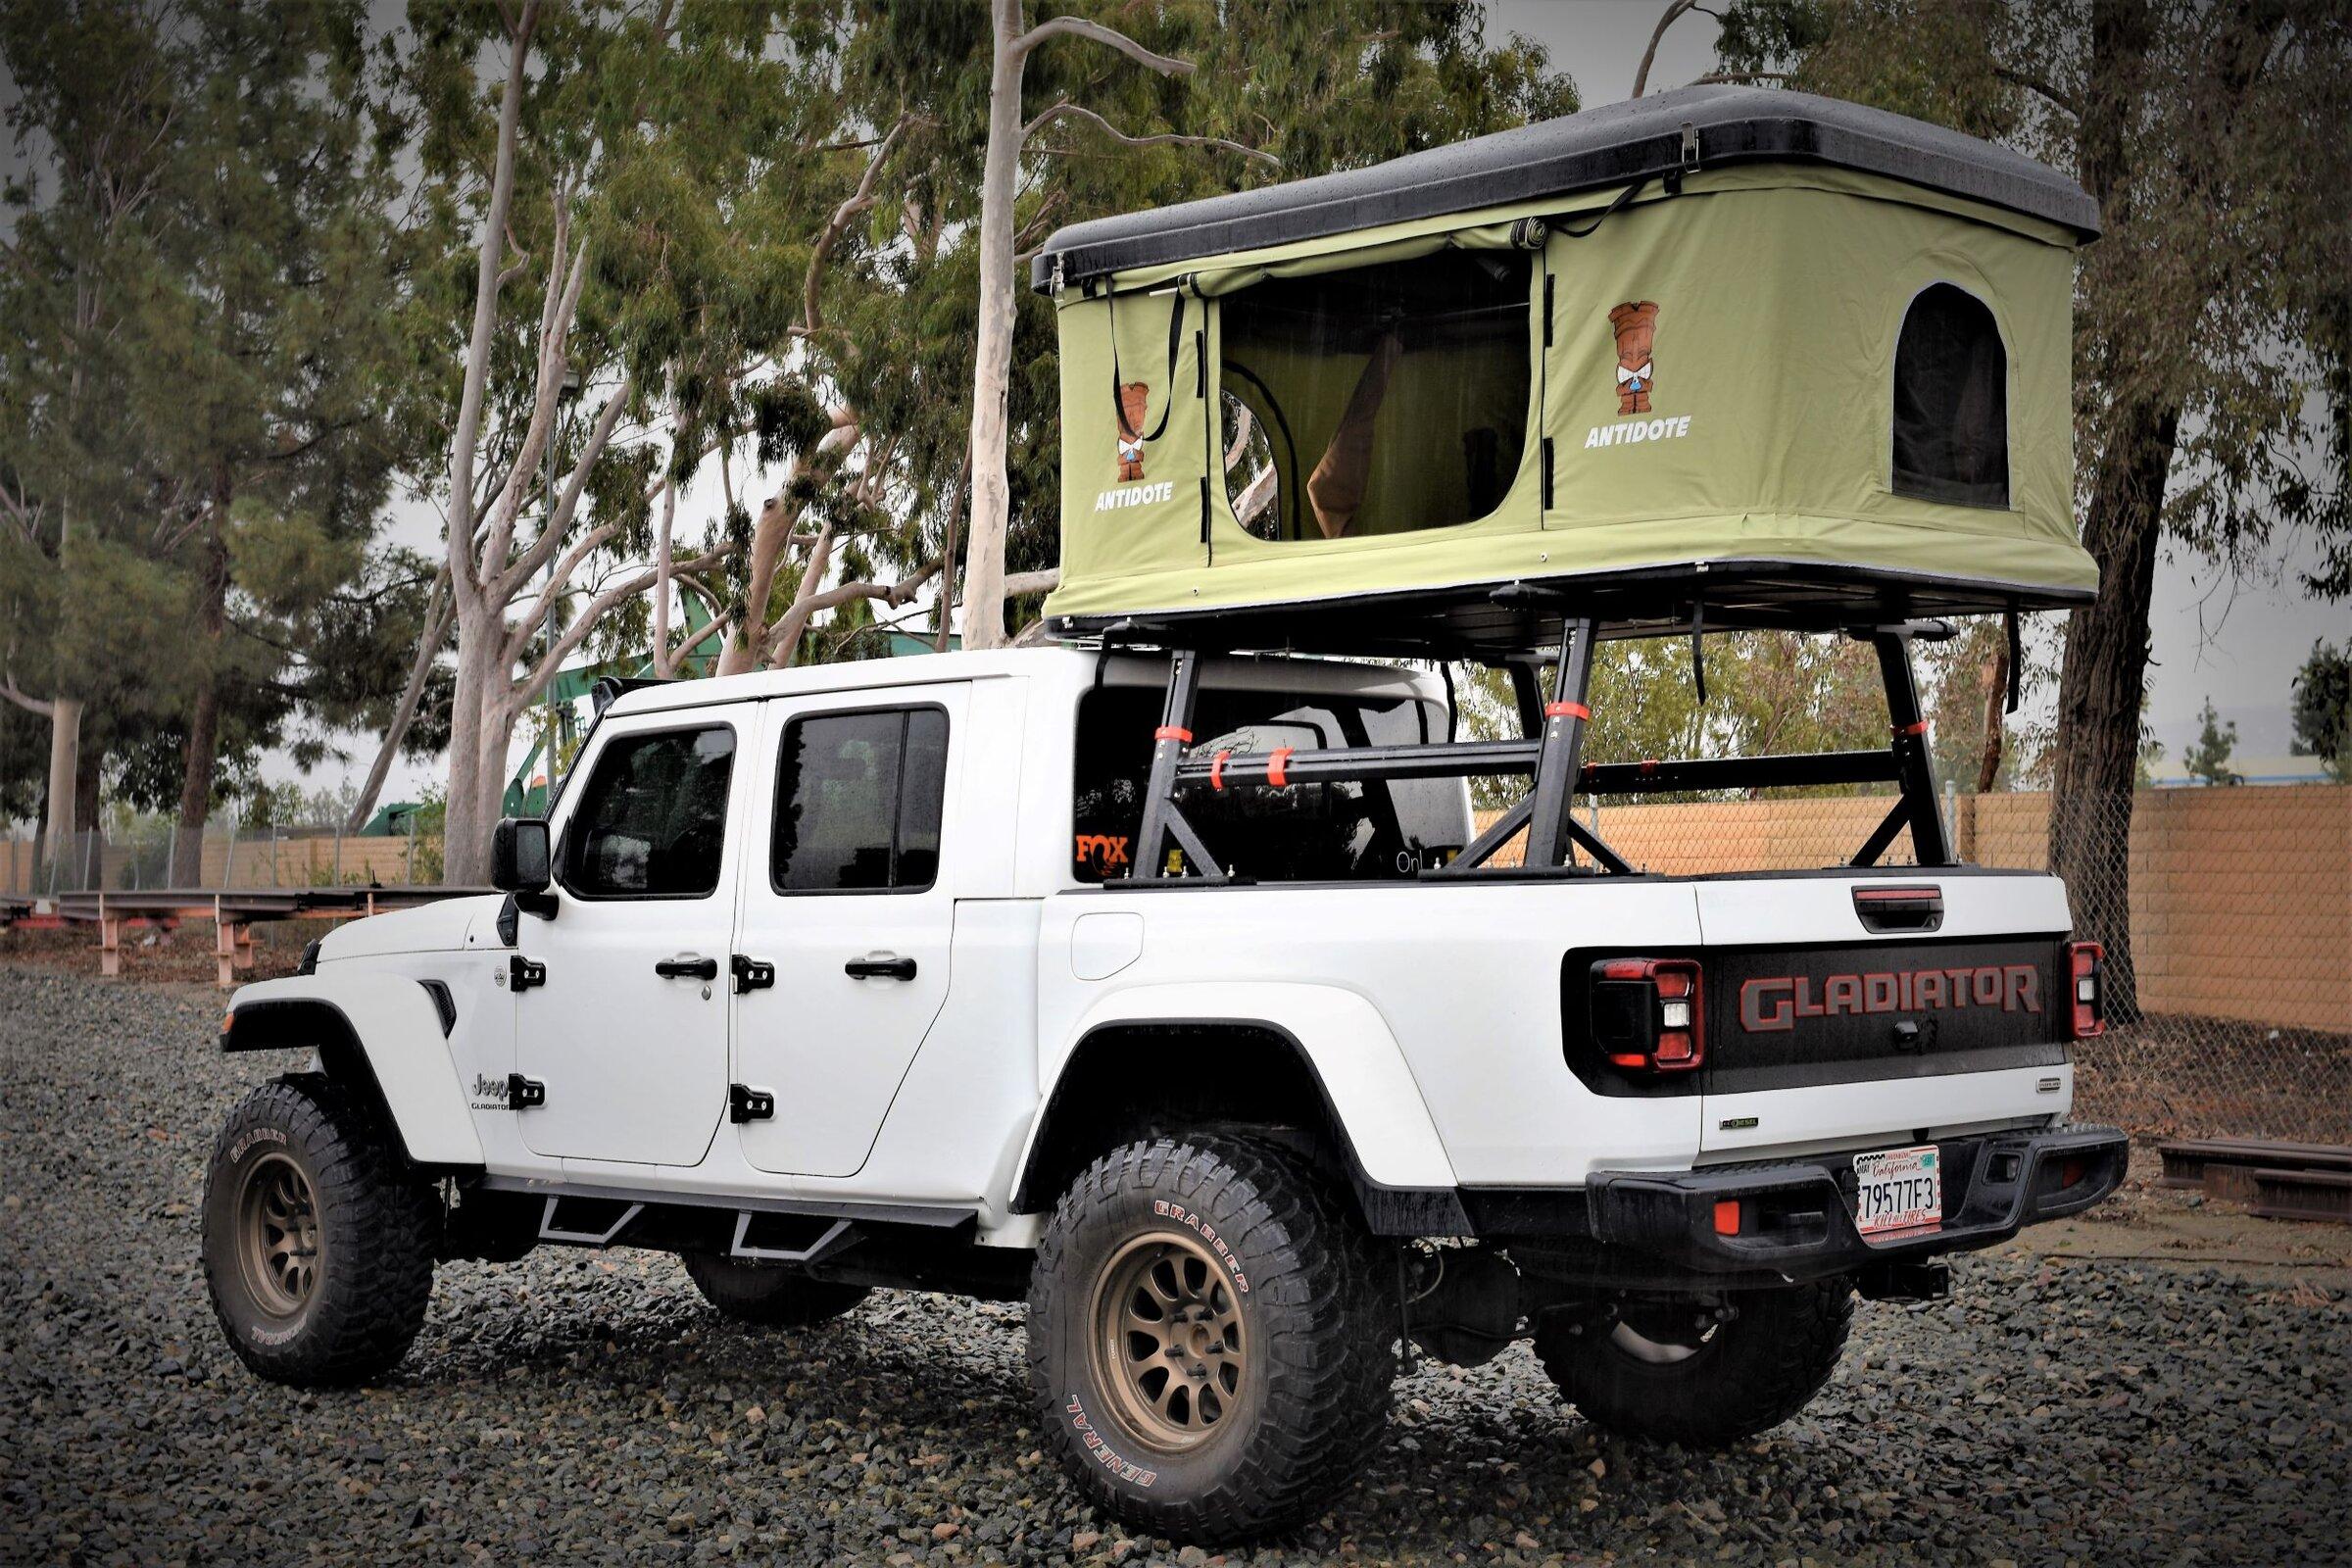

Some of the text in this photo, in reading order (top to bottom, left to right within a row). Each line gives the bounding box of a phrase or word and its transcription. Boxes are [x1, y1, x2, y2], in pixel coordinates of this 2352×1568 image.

[1584, 416, 1691, 449] ANTIDOTE
[1095, 481, 1173, 512] ANTIDOTE
[1076, 835, 1128, 866] FOX
[1396, 850, 1423, 872] Onl
[1740, 964, 2041, 1032] GLADIATOR
[472, 1073, 509, 1102] Jeep
[1862, 1178, 1934, 1218] 79577F3
[1154, 1200, 1249, 1293] GRABBER
[1066, 1395, 1157, 1487] GENERAL
